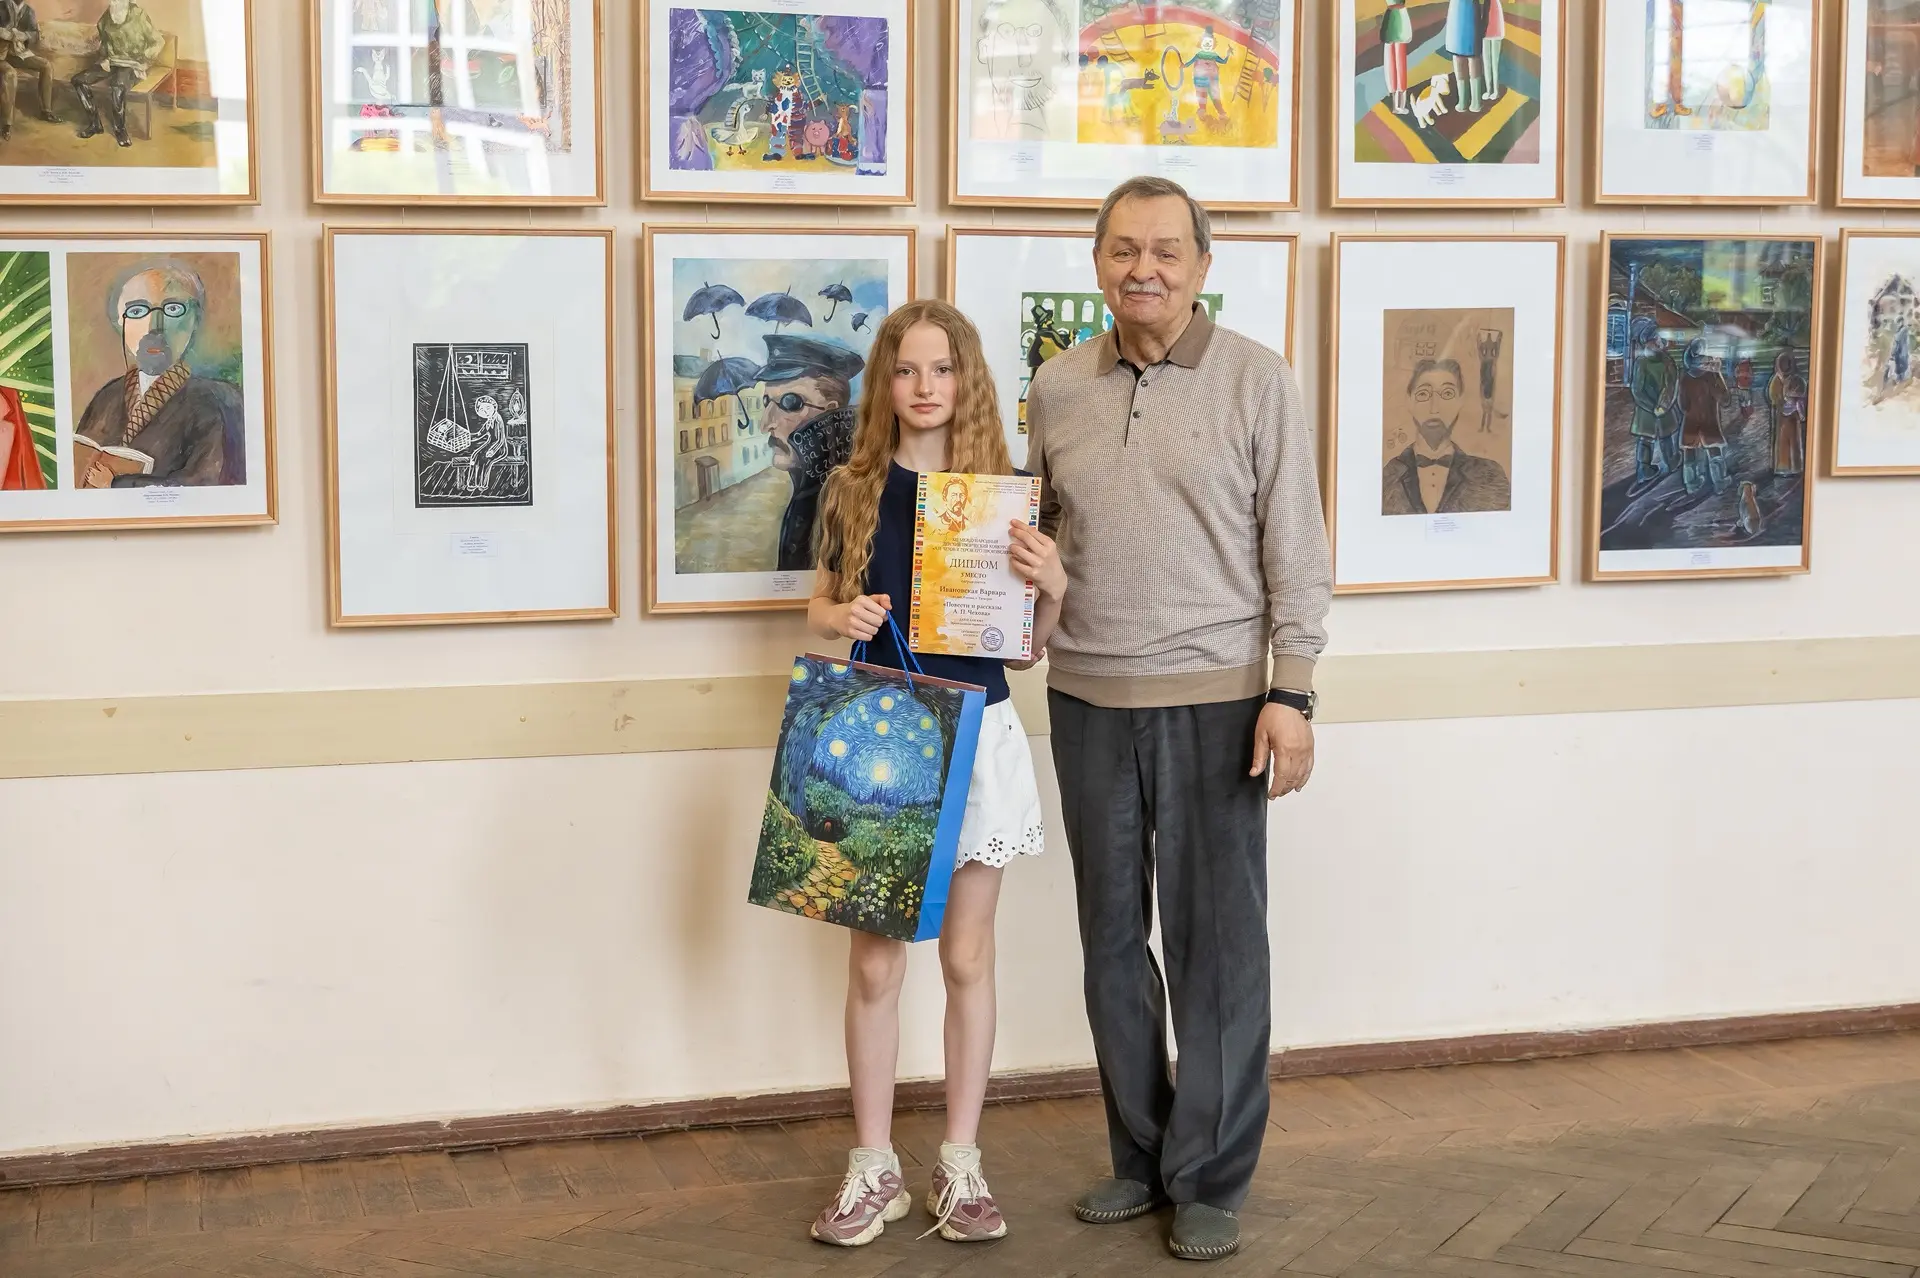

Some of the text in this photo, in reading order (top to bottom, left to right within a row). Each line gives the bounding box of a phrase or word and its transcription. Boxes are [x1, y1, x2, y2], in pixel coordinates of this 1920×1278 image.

[793, 428, 813, 445] Оно
[816, 425, 833, 440] это
[949, 558, 998, 570] ДИПЛОМ
[979, 589, 1007, 597] Варвара
